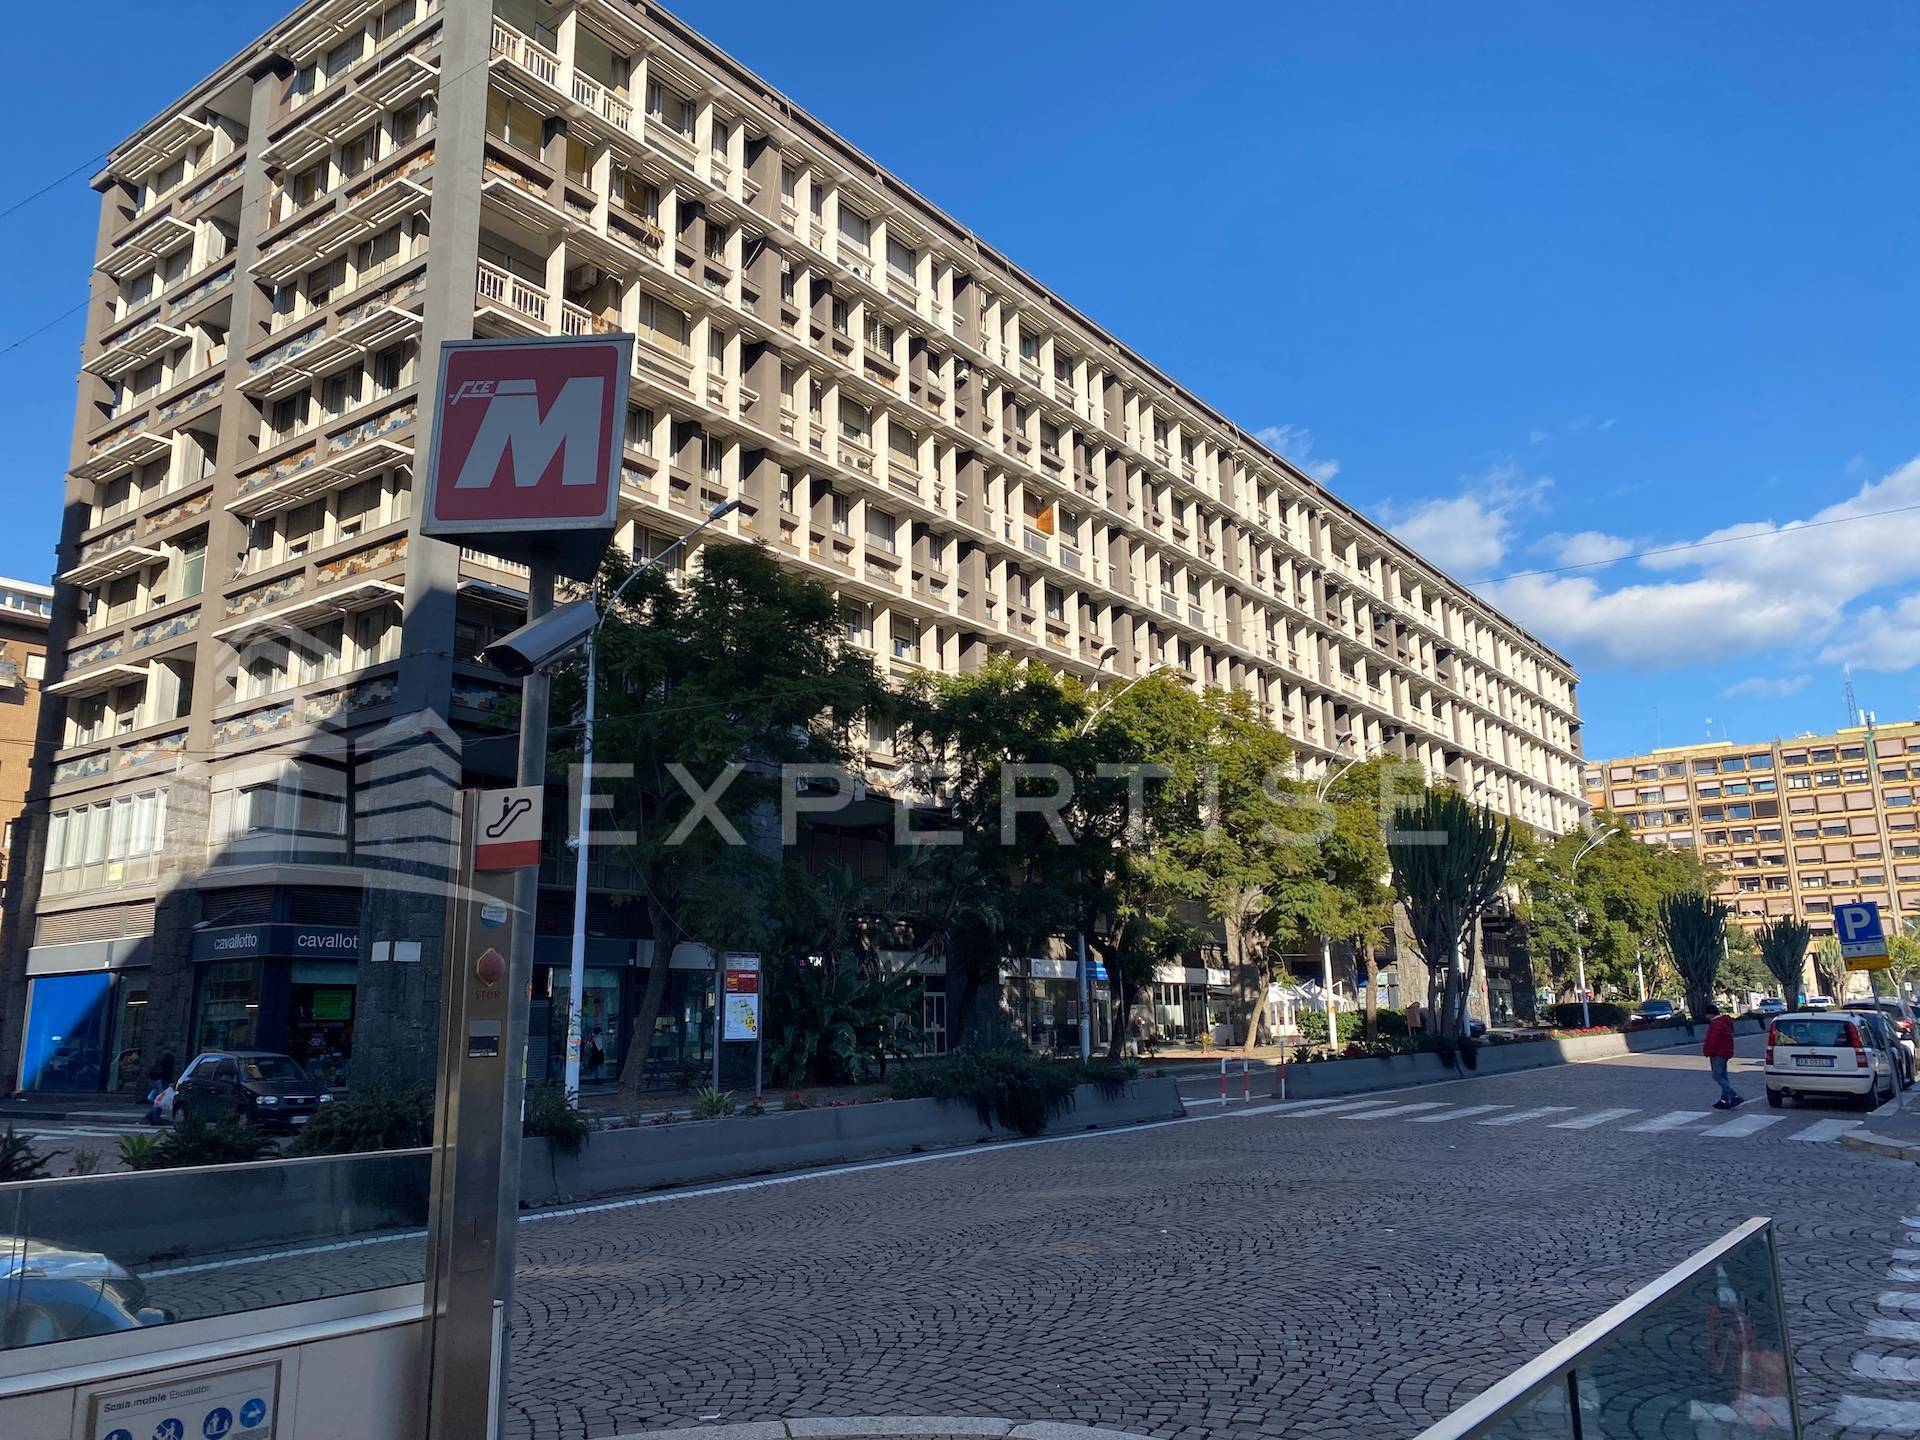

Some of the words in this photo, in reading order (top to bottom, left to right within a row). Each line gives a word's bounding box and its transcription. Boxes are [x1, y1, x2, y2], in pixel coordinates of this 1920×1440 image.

[453, 375, 605, 489] M
[1842, 907, 1872, 940] P
[213, 933, 257, 950] cavallotto
[474, 990, 500, 1000] STOP
[103, 1400, 130, 1413] Scala
